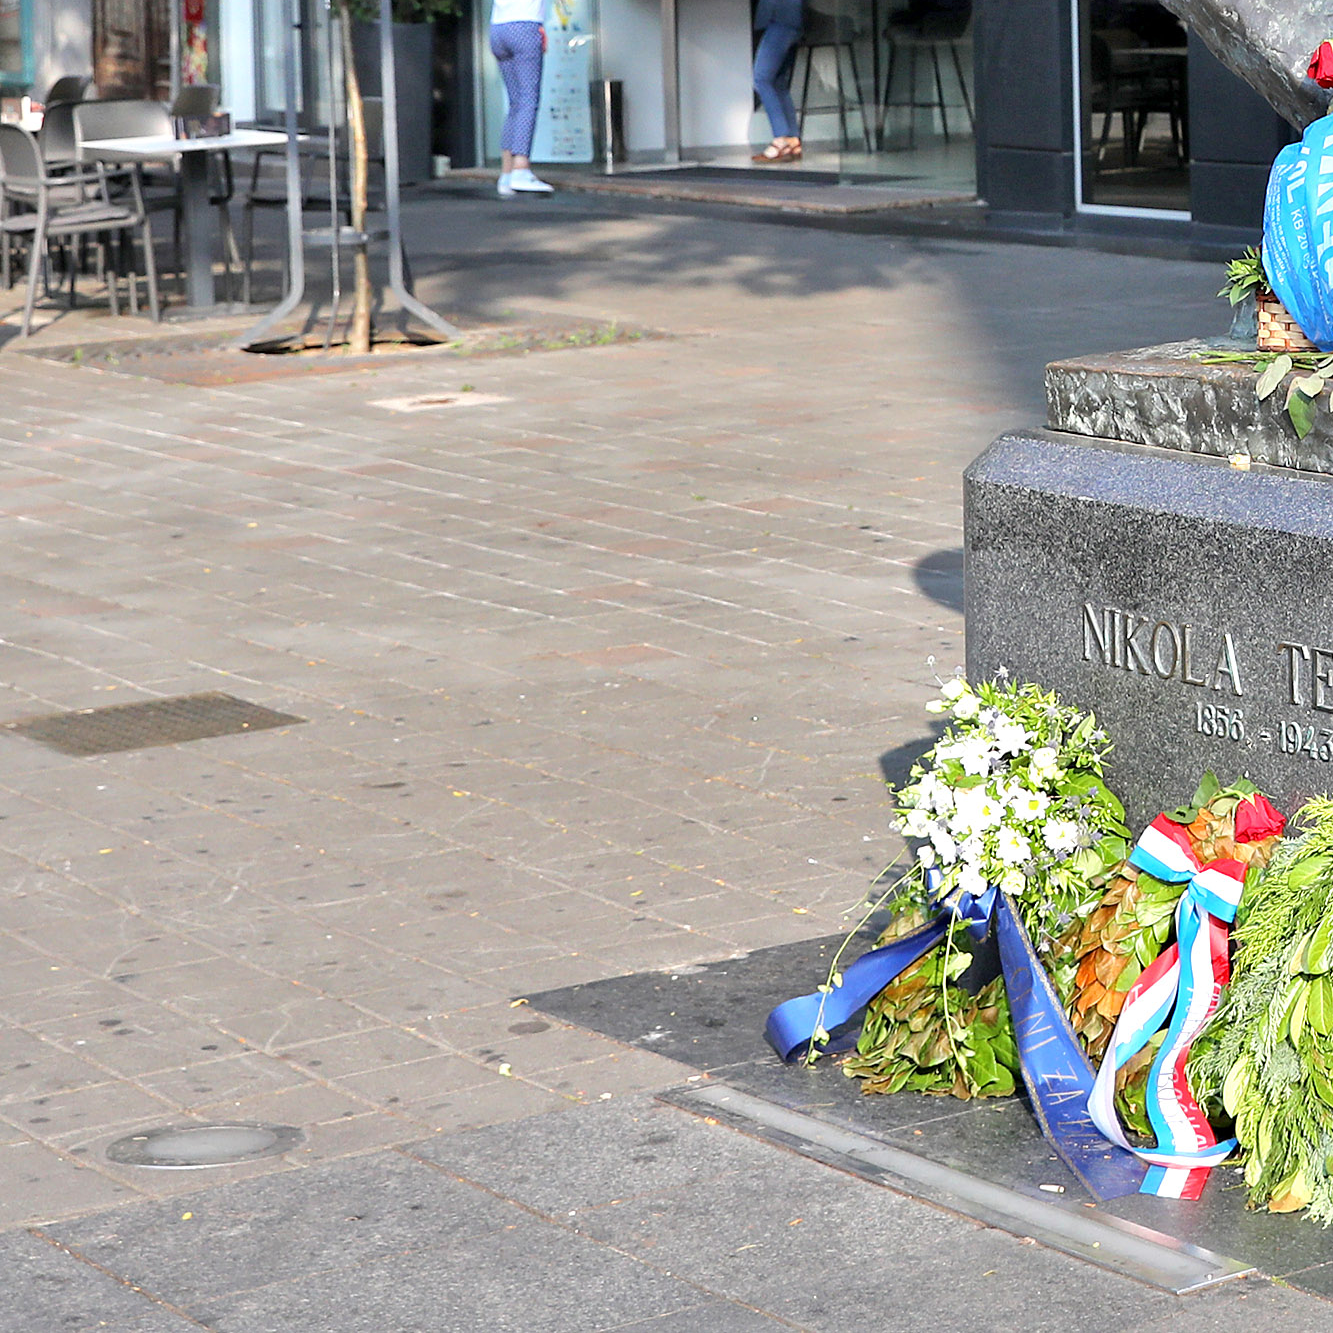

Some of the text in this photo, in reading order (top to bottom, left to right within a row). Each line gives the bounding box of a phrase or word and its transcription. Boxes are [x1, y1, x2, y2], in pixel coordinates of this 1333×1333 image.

[1291, 208, 1304, 230] KB
[1297, 233, 1308, 250] 20
[1082, 602, 1243, 697] NIKOLA
[1196, 700, 1251, 746] 1856.
